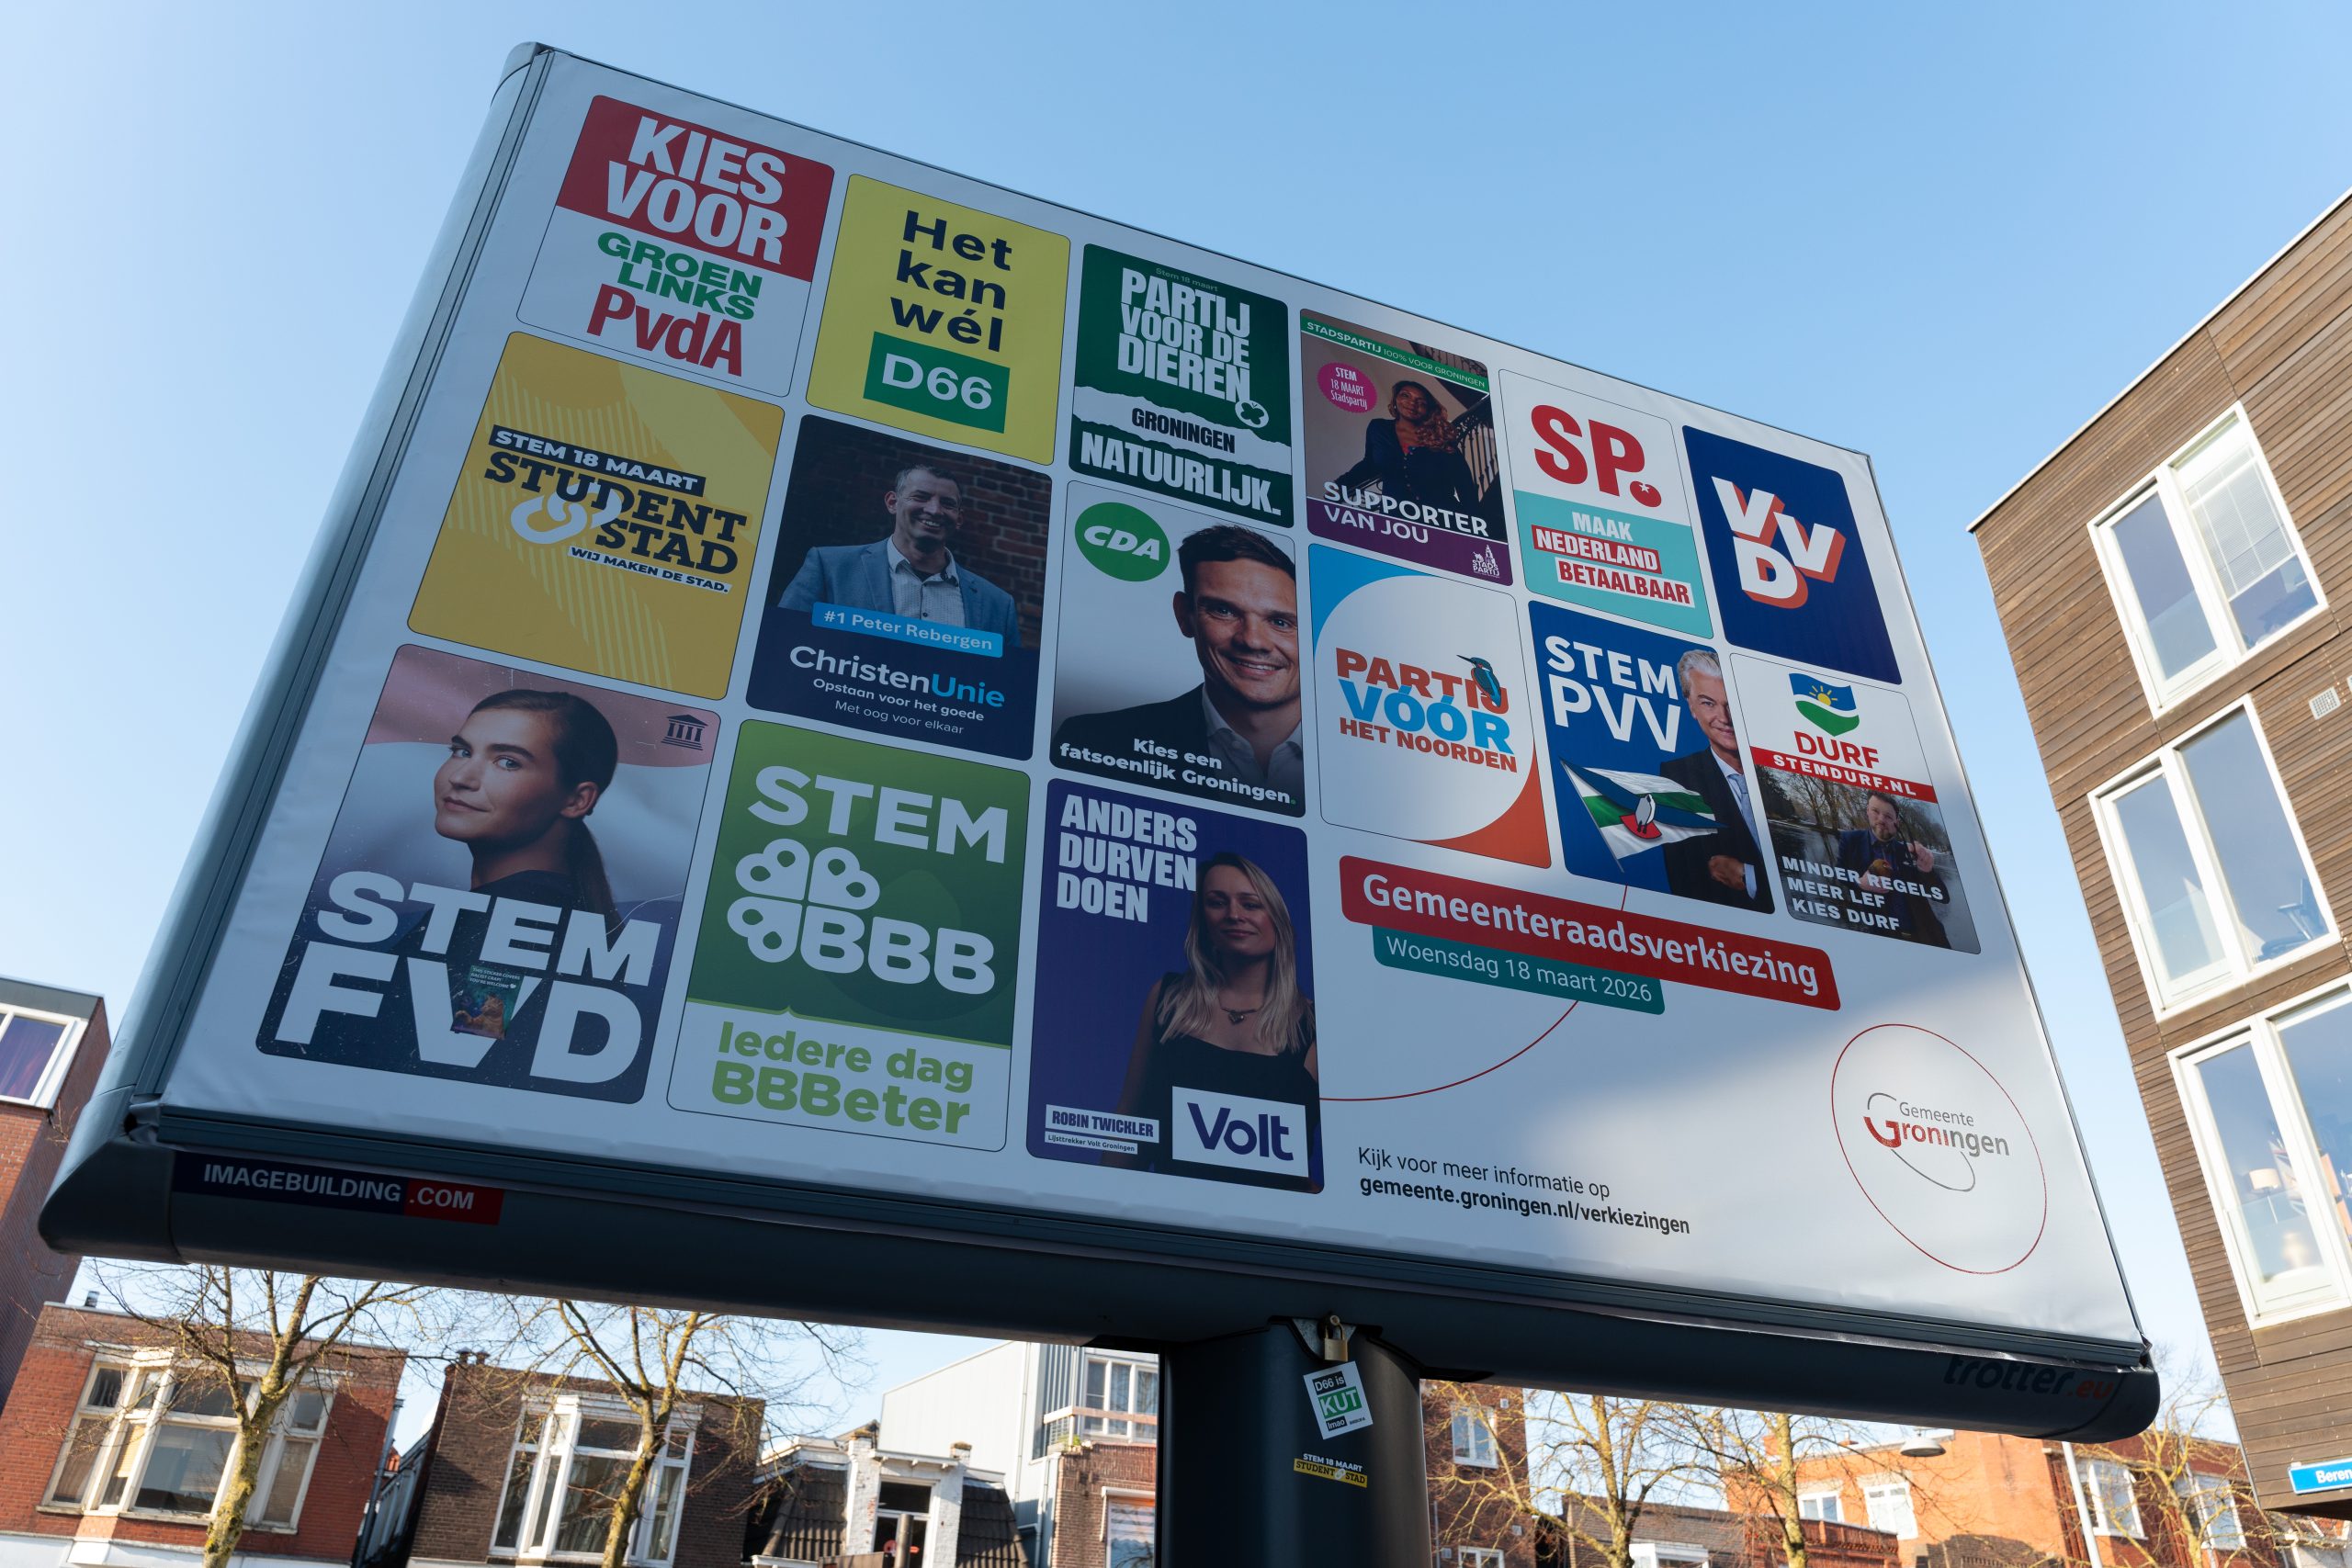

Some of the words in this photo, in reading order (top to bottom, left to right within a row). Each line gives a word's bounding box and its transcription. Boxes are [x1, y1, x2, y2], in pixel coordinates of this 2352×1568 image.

[628, 116, 786, 204] KIES
[607, 161, 787, 265] VOOR
[903, 209, 1012, 271] Het
[598, 232, 762, 298] GROEN
[617, 262, 755, 320] LINKS
[897, 249, 1006, 310] kan
[1156, 268, 1179, 279] Stem
[1193, 280, 1218, 291] maart
[890, 297, 1002, 352] wél
[1121, 267, 1250, 338] PARTIJ
[587, 284, 741, 377] PvdA
[1121, 303, 1203, 355] VOOR
[1213, 330, 1250, 369] DE
[1307, 322, 1381, 353] STADSPARTIJ
[1384, 349, 1407, 362] 100%
[1408, 358, 1432, 370] VOOR
[1435, 367, 1485, 388] GRONINGEN
[882, 353, 991, 409] D66
[1118, 333, 1250, 403] DIEREN
[1331, 379, 1339, 389] 18
[1341, 382, 1363, 396] MAART
[1336, 367, 1356, 381] STEM
[1331, 390, 1367, 410] Stadspartij
[1132, 408, 1235, 454] GRONINGEN
[495, 431, 567, 459] STEM
[573, 449, 599, 467] 18
[605, 458, 697, 490] MAART
[1081, 432, 1281, 515] NATUURLIJK.
[484, 452, 747, 543] STUDENT
[1324, 506, 1374, 531] VAN
[1381, 520, 1429, 543] JOU
[1325, 481, 1488, 537] SUPPORTER
[595, 519, 738, 574] STAD
[1084, 526, 1159, 560] CDA
[1535, 529, 1657, 571] NEDERLAND
[1572, 511, 1632, 541] MAAK
[571, 547, 600, 561] WIJ
[604, 556, 658, 576] MAKEN
[662, 569, 683, 581] DE
[686, 576, 729, 592] STAD.
[1473, 560, 1498, 570] STADS
[1474, 566, 1499, 576] PARTIJ
[1558, 560, 1690, 604] BETAALBAAR
[823, 610, 845, 625] #1
[853, 614, 900, 634] Peter
[906, 625, 992, 649] Rebergen
[790, 646, 1005, 707] ChristenUnie
[1336, 648, 1509, 715] PARTIJ
[1545, 636, 1680, 700] STEM
[813, 678, 875, 700] Opstaan
[878, 694, 910, 707] voor
[914, 700, 936, 713] het
[941, 705, 984, 721] goede
[835, 700, 861, 715] Met
[864, 707, 888, 722] oog
[893, 714, 921, 726] voor
[925, 719, 964, 734] elkaar
[1549, 673, 1680, 752] PVV
[1134, 739, 1178, 760] Kies
[1184, 752, 1222, 769] een
[1340, 717, 1390, 743] HET
[1396, 730, 1517, 773] NOORDEN
[1794, 731, 1879, 769] DURF
[1060, 743, 1176, 780] fatsoenlijk
[1182, 770, 1296, 805] Groningen.
[1773, 755, 1917, 795] STEMDURF.NL
[748, 765, 1008, 863] STEM
[1060, 795, 1197, 852] ANDERS
[1058, 832, 1196, 892] DURVEN
[1781, 856, 1862, 883] MINDER
[1867, 874, 1943, 900] REGELS
[1057, 872, 1148, 923] DOEN
[1787, 877, 1842, 899] MEER
[1849, 892, 1884, 908] LEF
[1792, 898, 1840, 919] KIES
[1848, 909, 1900, 931] DURF
[317, 871, 662, 986] STEM
[800, 905, 995, 995] BBB
[1363, 874, 1819, 997] Gemeenteraadsverkiezing
[1386, 936, 1499, 979] Woensdag
[1505, 960, 1530, 980] 18
[1537, 968, 1598, 993] maart
[1601, 978, 1653, 1002] 2026
[276, 941, 642, 1083] FVD
[718, 1021, 872, 1073] Iedere
[886, 1048, 973, 1093] dag
[712, 1060, 970, 1134] BBBeter
[1052, 1111, 1089, 1128] ROBIN
[1091, 1116, 1153, 1137] TWICKLER
[1899, 1102, 1974, 1127] Gemeente
[1048, 1135, 1086, 1145] Lijsttrekker
[1102, 1142, 1135, 1152] Groningen
[1188, 1102, 1294, 1161] Volt
[1863, 1116, 2009, 1156] Groningen
[1359, 1147, 1393, 1170] Kijk
[1396, 1156, 1437, 1174] voor
[1443, 1162, 1488, 1181] meer
[1494, 1166, 1584, 1194] informatie
[1589, 1181, 1610, 1200] op
[1360, 1177, 1690, 1235] gemeente.groningen.nl/verkiezingen
[1315, 1378, 1334, 1391] D66
[1335, 1376, 1345, 1385] is
[1320, 1389, 1357, 1416] KUT
[1943, 1356, 2113, 1400] trotter.eu
[1328, 1419, 1345, 1429] lmao
[1296, 1461, 1335, 1476] STUDENT
[1346, 1473, 1365, 1483] STAD
[1303, 1453, 1324, 1463] STEM
[1336, 1461, 1363, 1472] MAART
